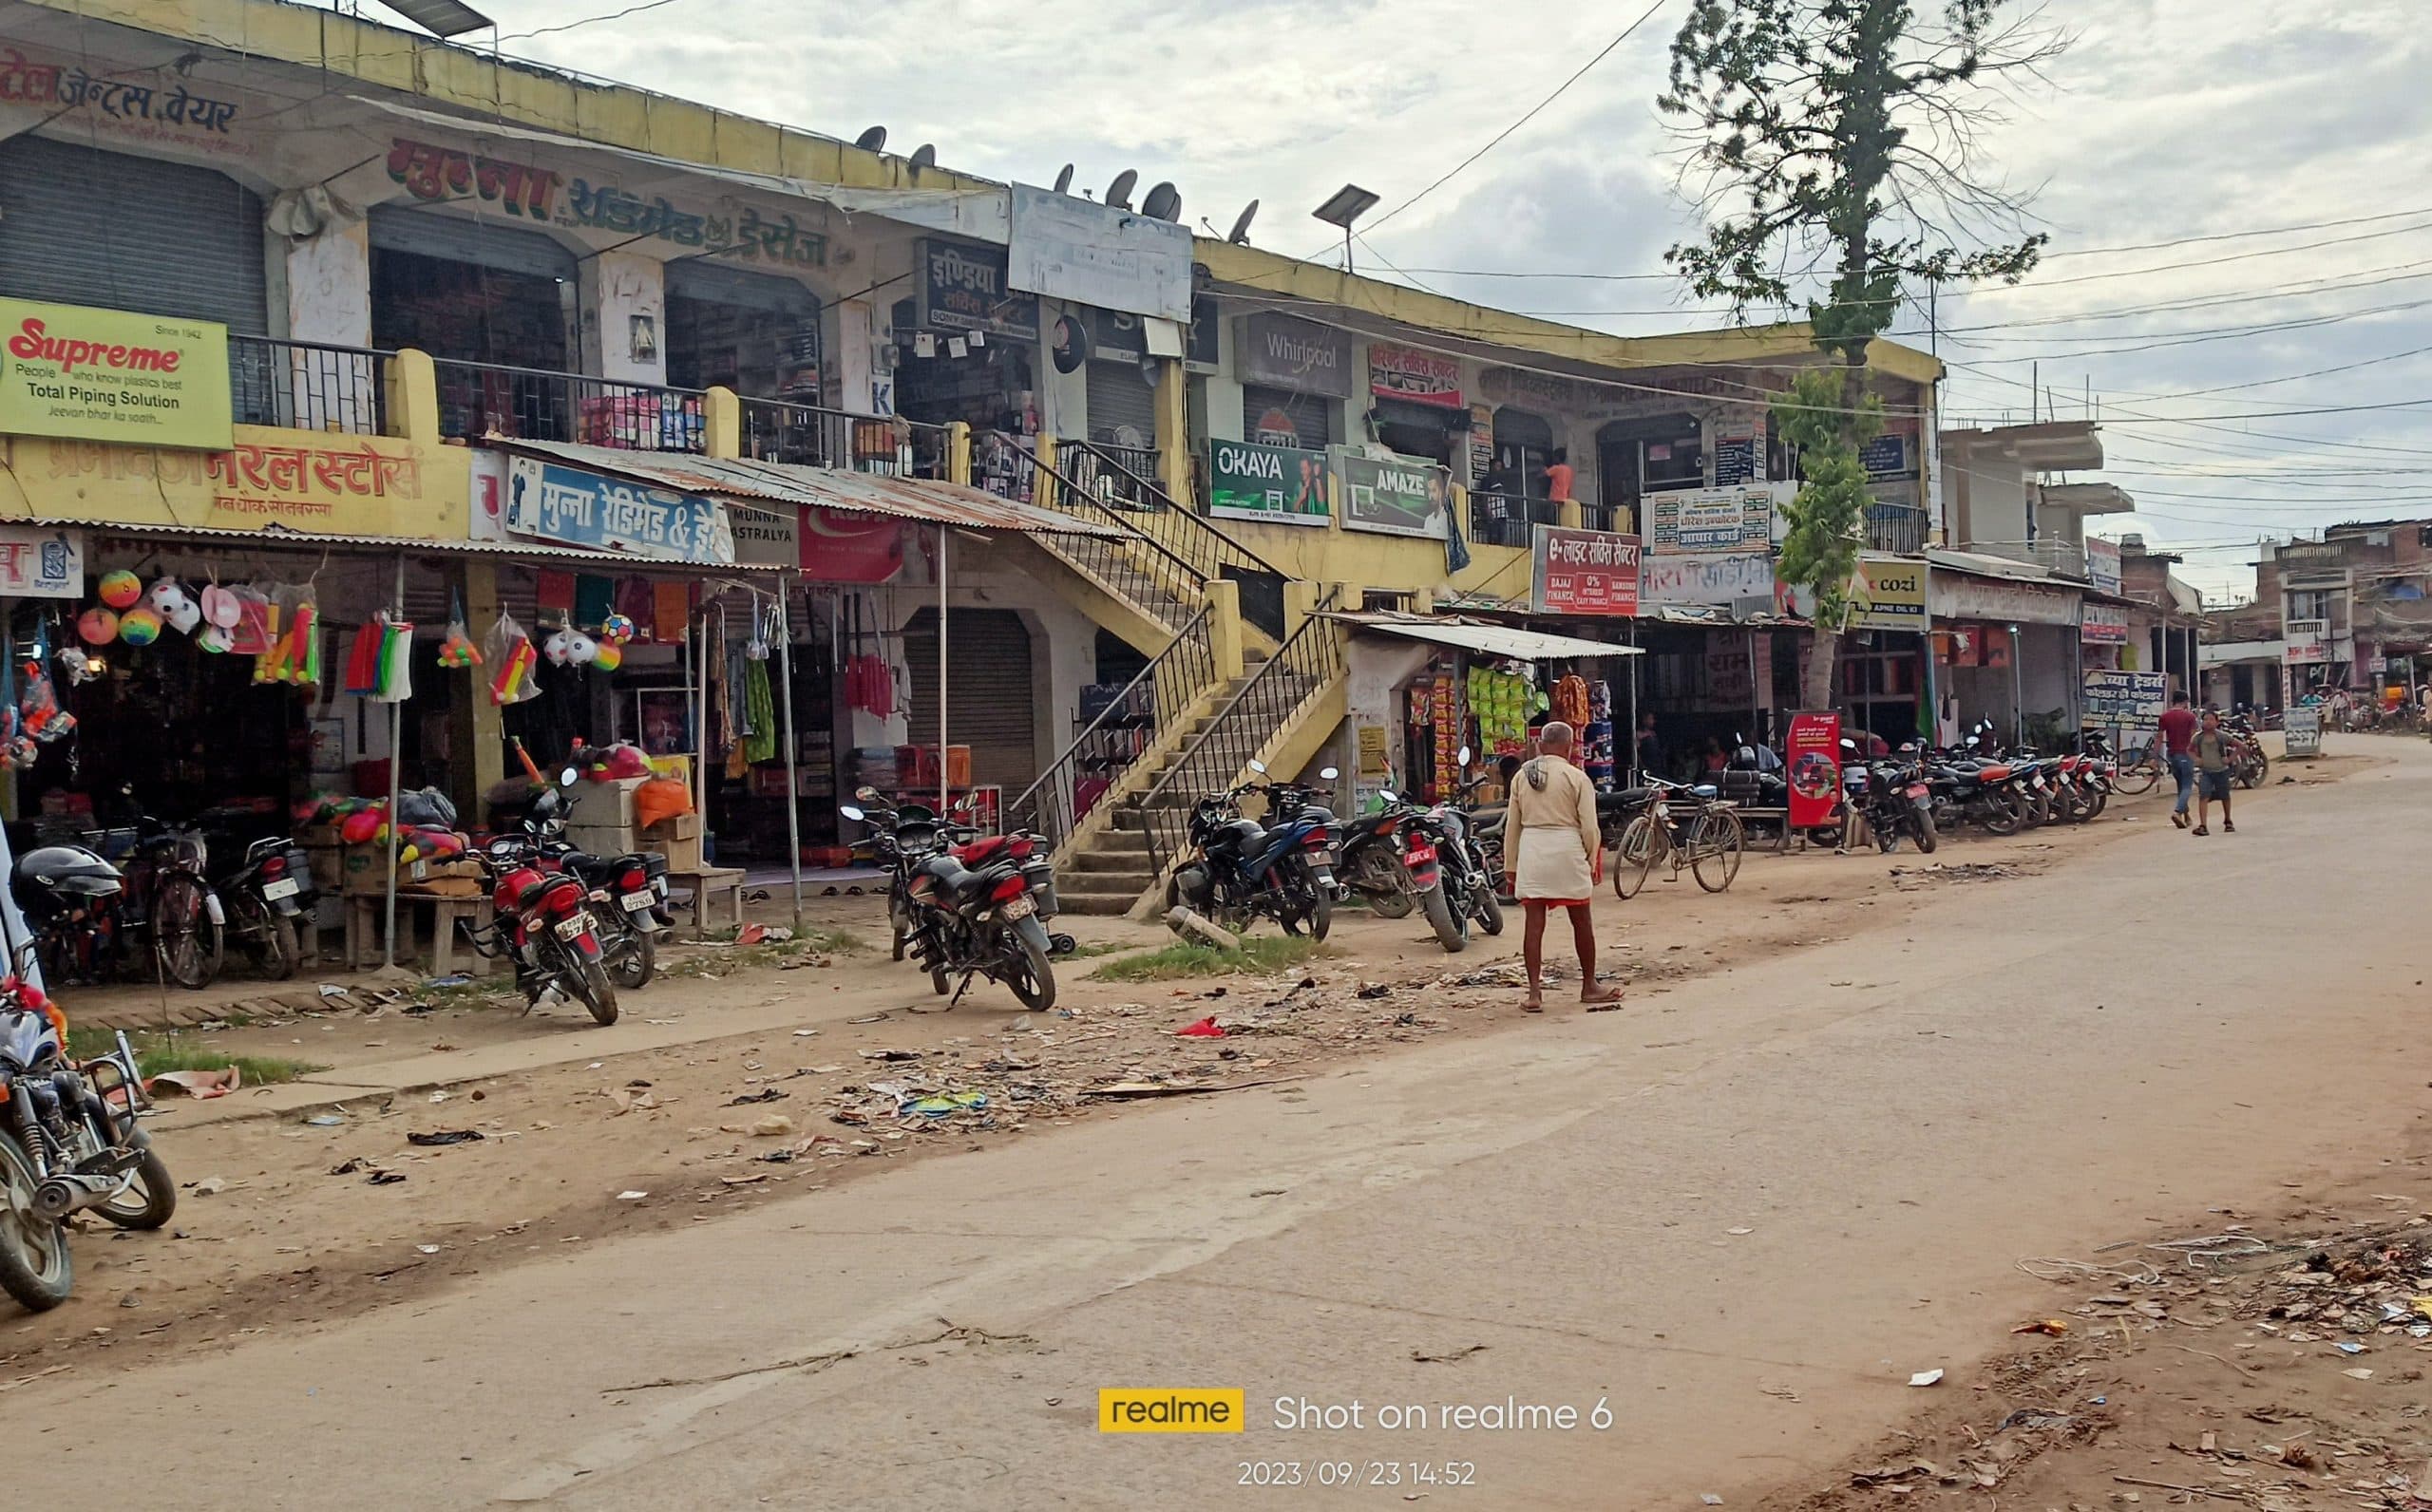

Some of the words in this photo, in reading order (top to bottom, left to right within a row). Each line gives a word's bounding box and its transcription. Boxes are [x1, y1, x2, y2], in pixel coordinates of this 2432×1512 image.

[155, 325, 180, 336] Since
[9, 318, 180, 373] Supreme
[1266, 332, 1337, 371] Whirlpool
[15, 364, 57, 379] People
[73, 371, 93, 382] who
[96, 372, 122, 384] know
[124, 377, 161, 388] plastics
[162, 380, 182, 390] best
[27, 383, 66, 400] Total
[69, 387, 117, 406] Piping
[121, 391, 180, 408] Solution
[48, 406, 85, 419] Jeevan
[87, 408, 111, 420] bhar
[114, 410, 125, 422] ka
[1218, 446, 1282, 480] OKAYA
[1378, 469, 1425, 496] AMAZE
[542, 481, 596, 532] मुन्ना
[598, 482, 669, 544] रेडिमेड
[669, 506, 691, 549] &
[733, 509, 780, 523] MUNNA
[1588, 535, 1612, 565] सर्विस
[1613, 538, 1638, 567] सेन्टर
[1586, 575, 1600, 587] 0%
[1880, 575, 1917, 592] cozi
[1547, 591, 1575, 601] FINANCE
[1611, 593, 1636, 601] FINANCE
[1873, 604, 1894, 613] APNE
